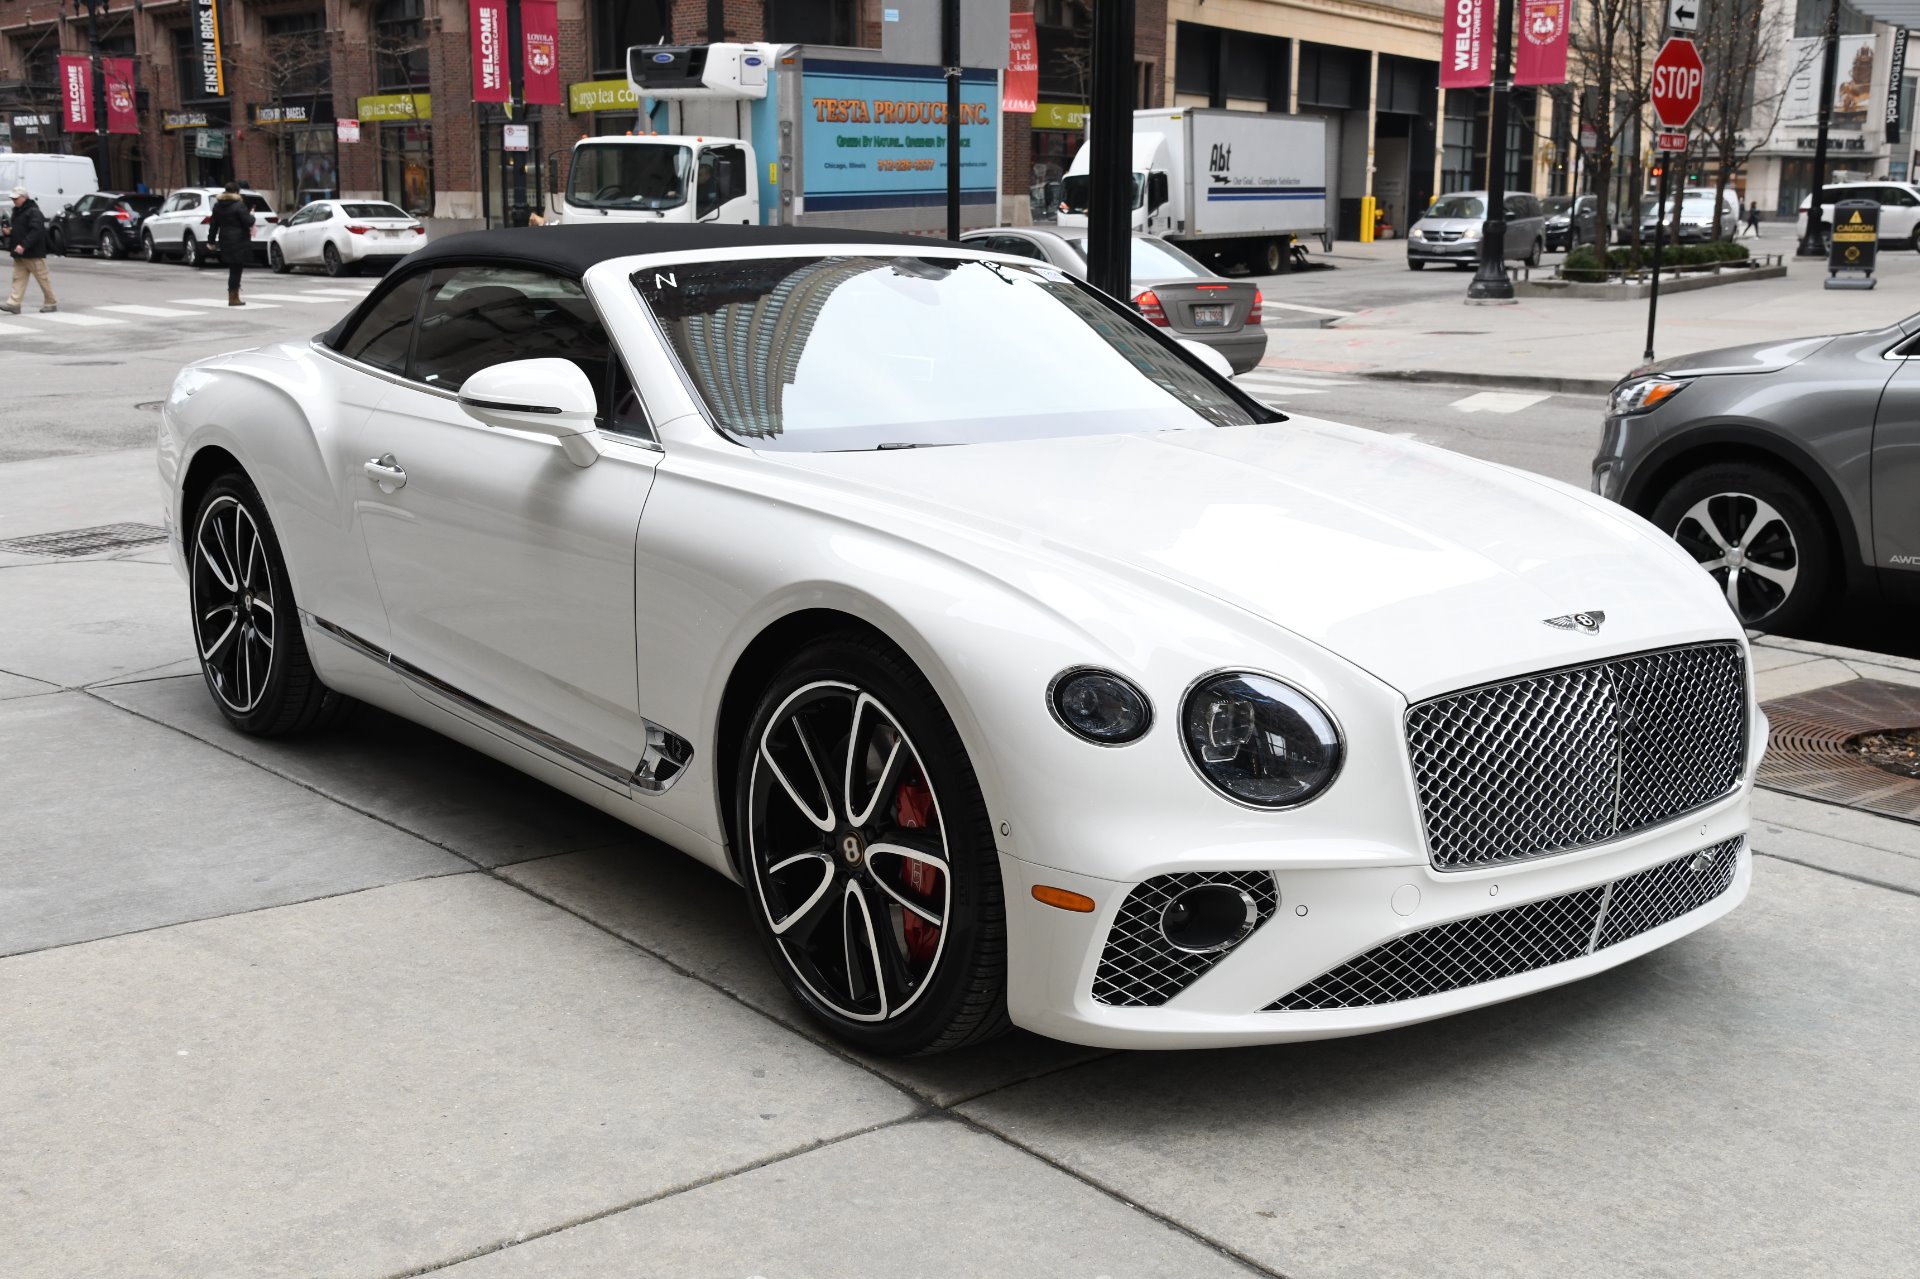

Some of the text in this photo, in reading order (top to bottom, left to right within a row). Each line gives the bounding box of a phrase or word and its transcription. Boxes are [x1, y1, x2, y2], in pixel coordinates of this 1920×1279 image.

[527, 33, 553, 41] LOYOLA
[1454, 0, 1472, 71] WELCO
[1473, 7, 1481, 39] TOWER
[480, 8, 494, 88] WELCOME
[1470, 40, 1480, 71] WATER
[202, 42, 219, 93] EINSTEIN
[1655, 65, 1700, 100] STOP
[1886, 29, 1905, 123] ORDSTROM rack
[68, 65, 82, 123] WELCOME
[599, 88, 614, 103] tea
[286, 106, 306, 119] BAGELS
[813, 98, 870, 123] TESTA
[1661, 134, 1672, 146] ALL
[1673, 134, 1685, 147] WAY
[1209, 143, 1231, 172] Abt
[1836, 224, 1874, 232] CAUTION
